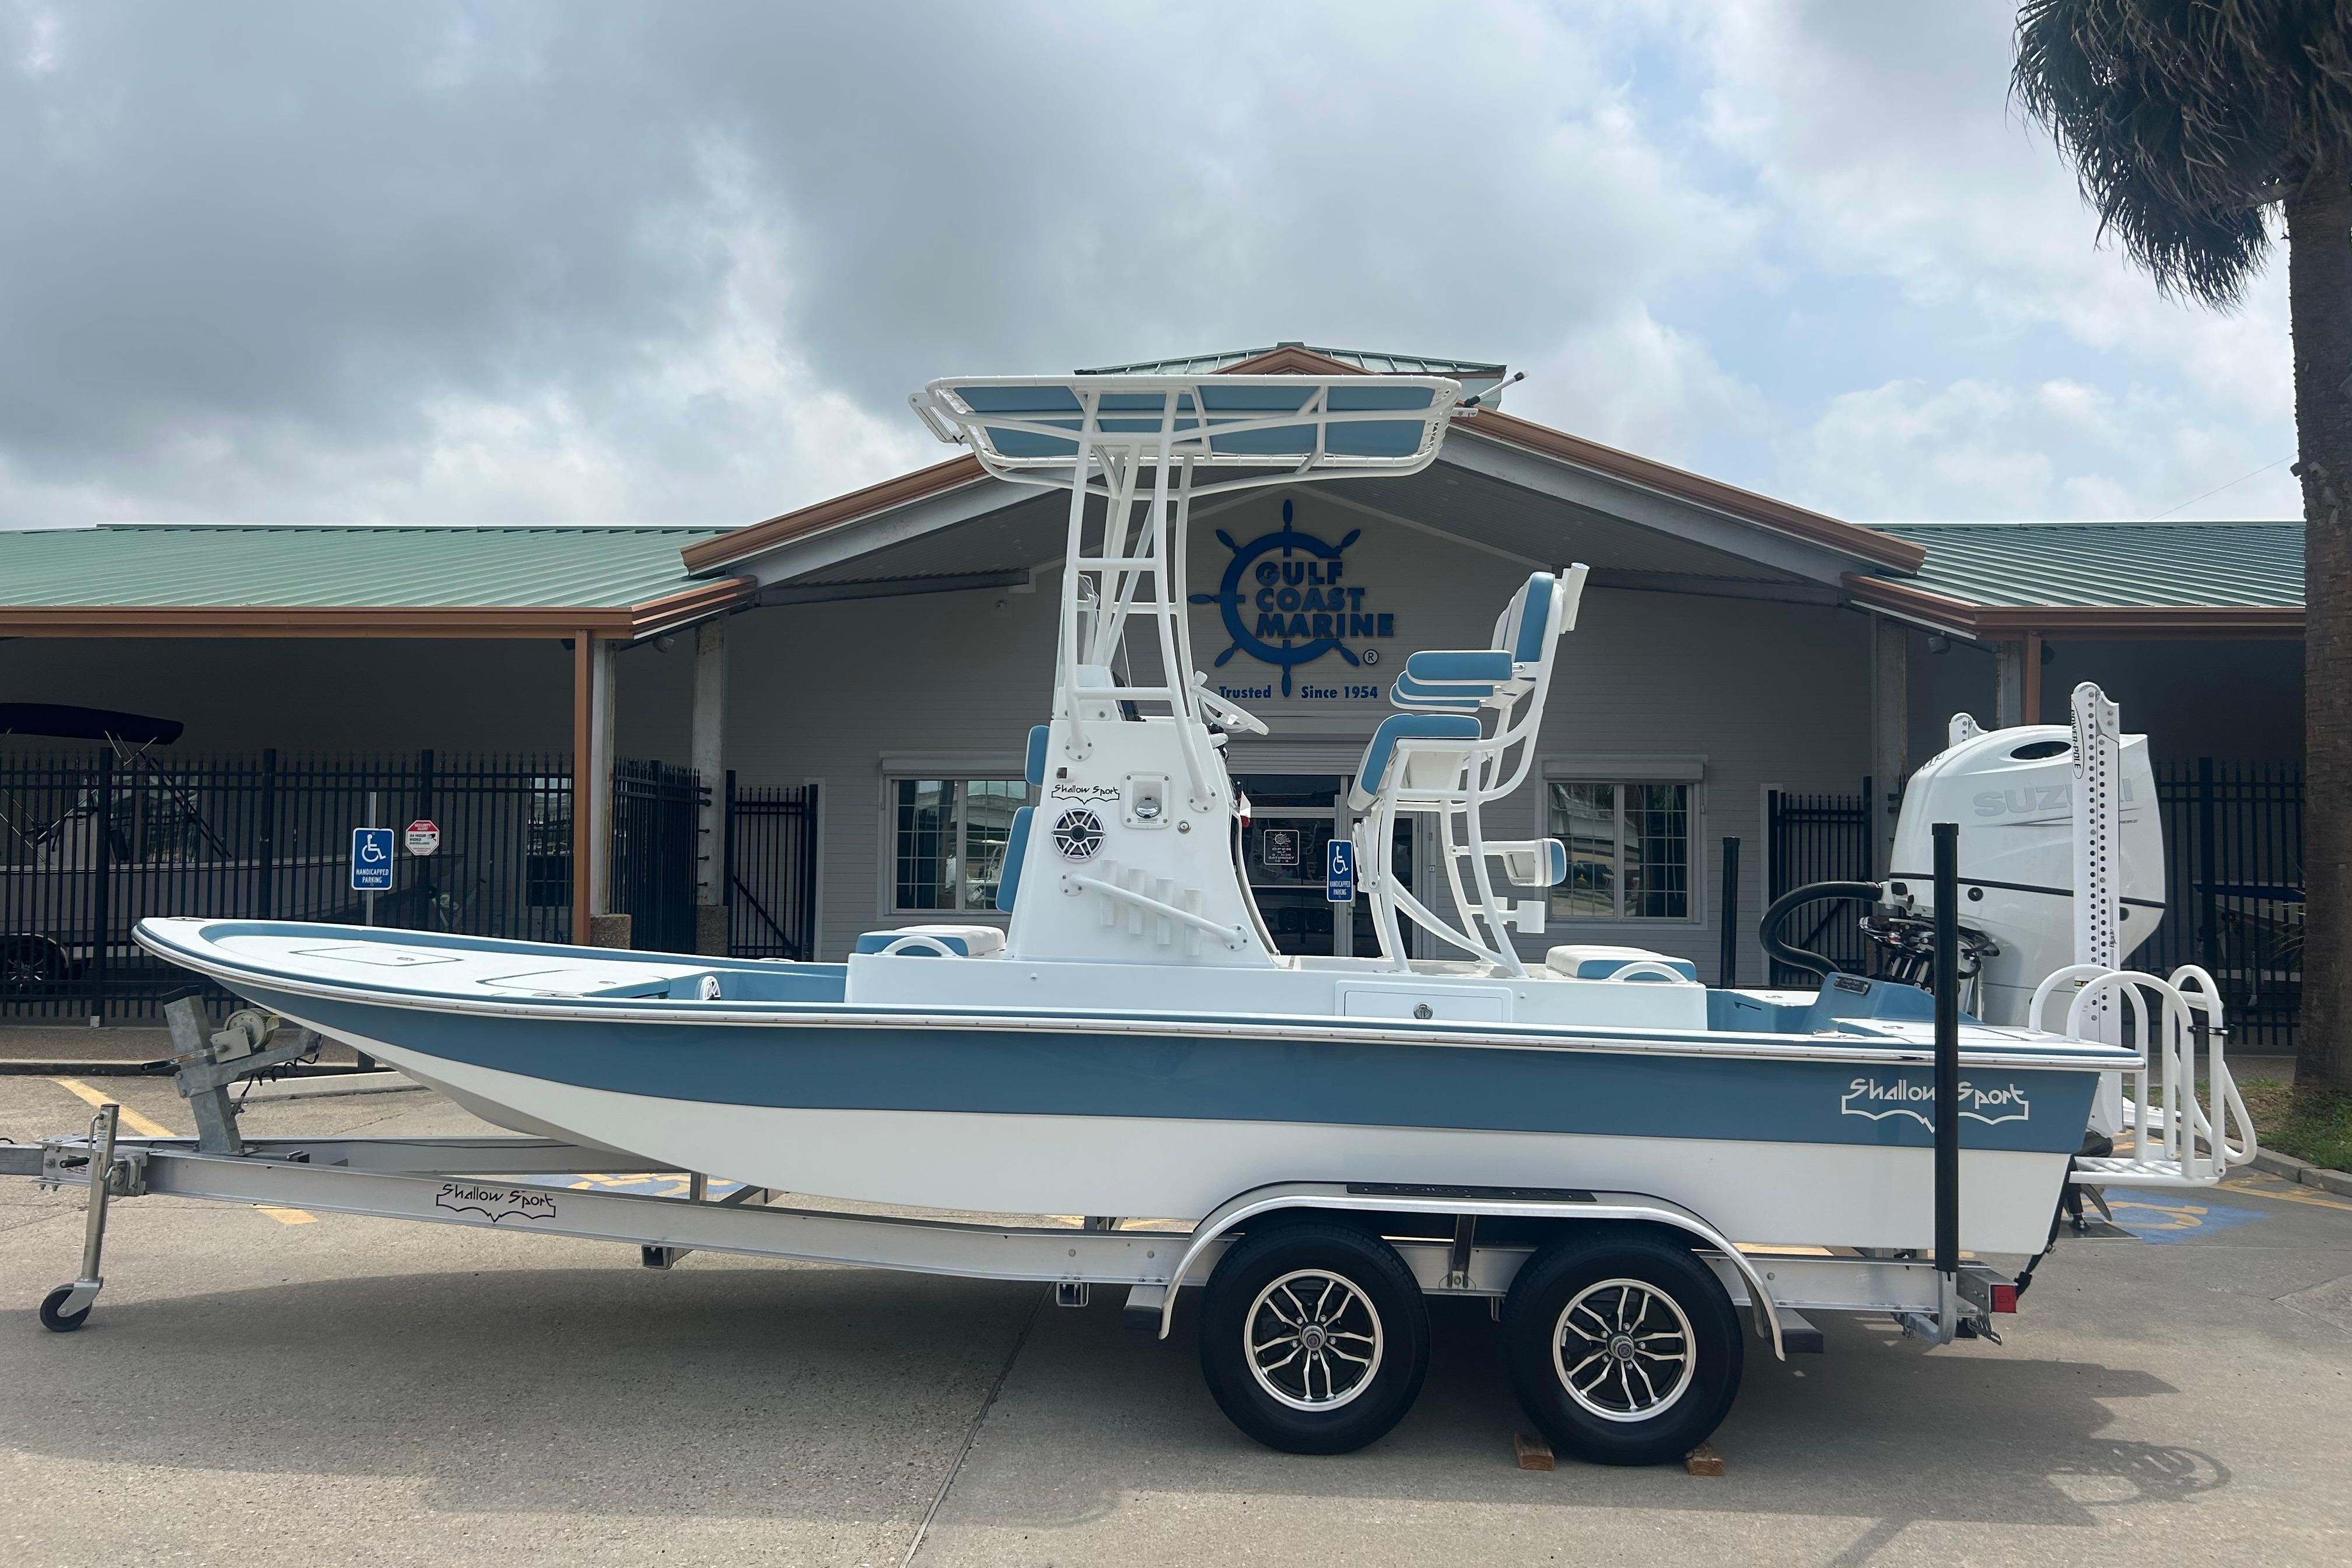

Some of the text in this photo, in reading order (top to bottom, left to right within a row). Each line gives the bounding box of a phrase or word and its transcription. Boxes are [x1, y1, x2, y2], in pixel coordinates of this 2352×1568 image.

[1255, 561, 1343, 586] GULF
[1255, 587, 1366, 612] COAST
[1255, 613, 1394, 639] MARINE
[1219, 685, 1378, 699] Trusted Since 1954
[2071, 709, 2081, 769] POWER-POLE
[1054, 784, 1119, 797] Shallow Sport
[1972, 778, 2133, 817] SUZI
[442, 1184, 554, 1209] Shallow Sport
